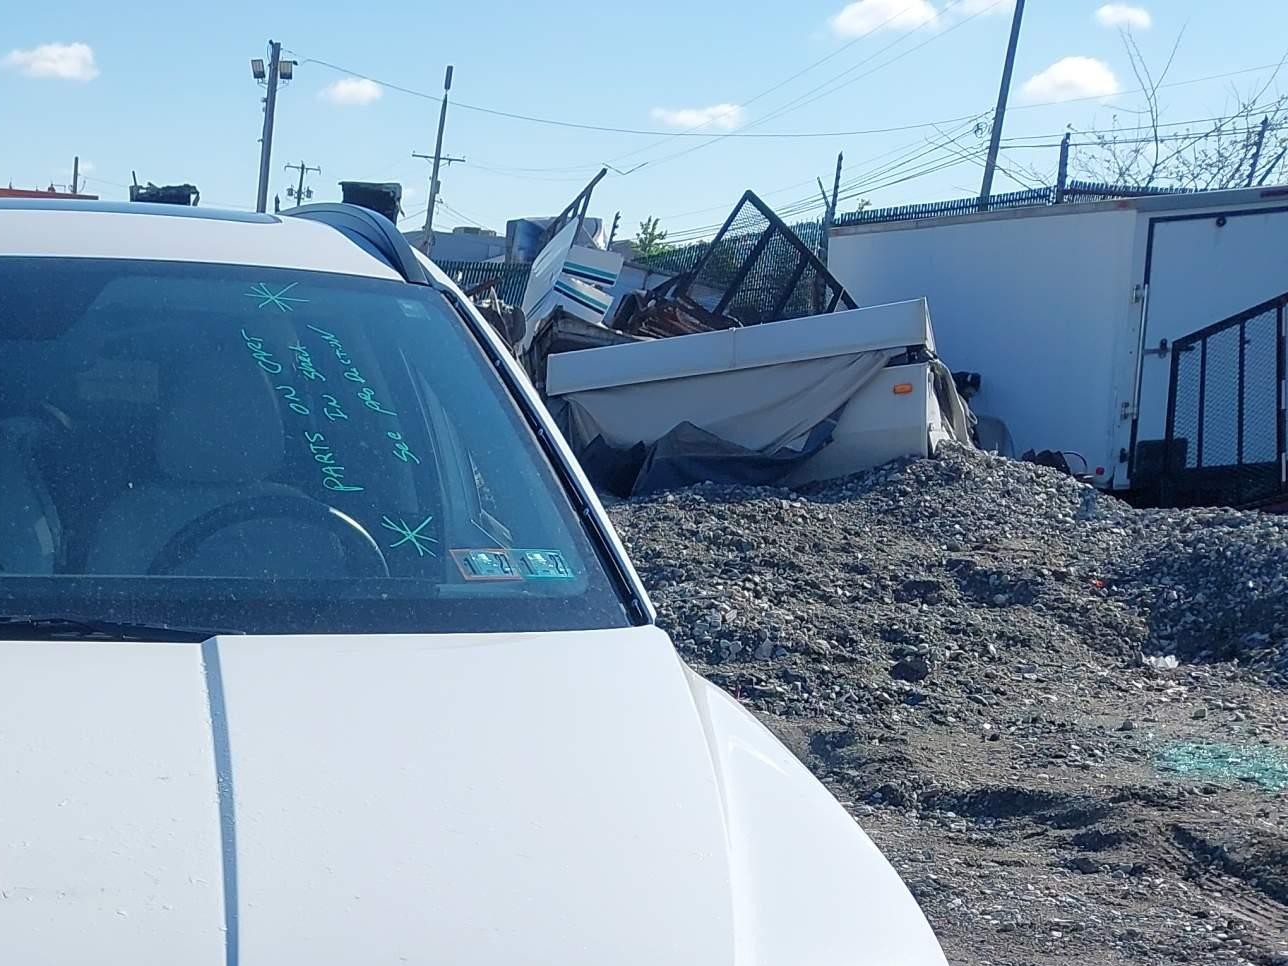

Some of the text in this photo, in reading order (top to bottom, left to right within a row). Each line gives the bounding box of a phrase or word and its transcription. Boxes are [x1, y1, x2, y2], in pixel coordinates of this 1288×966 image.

[241, 328, 364, 491] PARTS ON CART
[321, 394, 349, 421] IN
